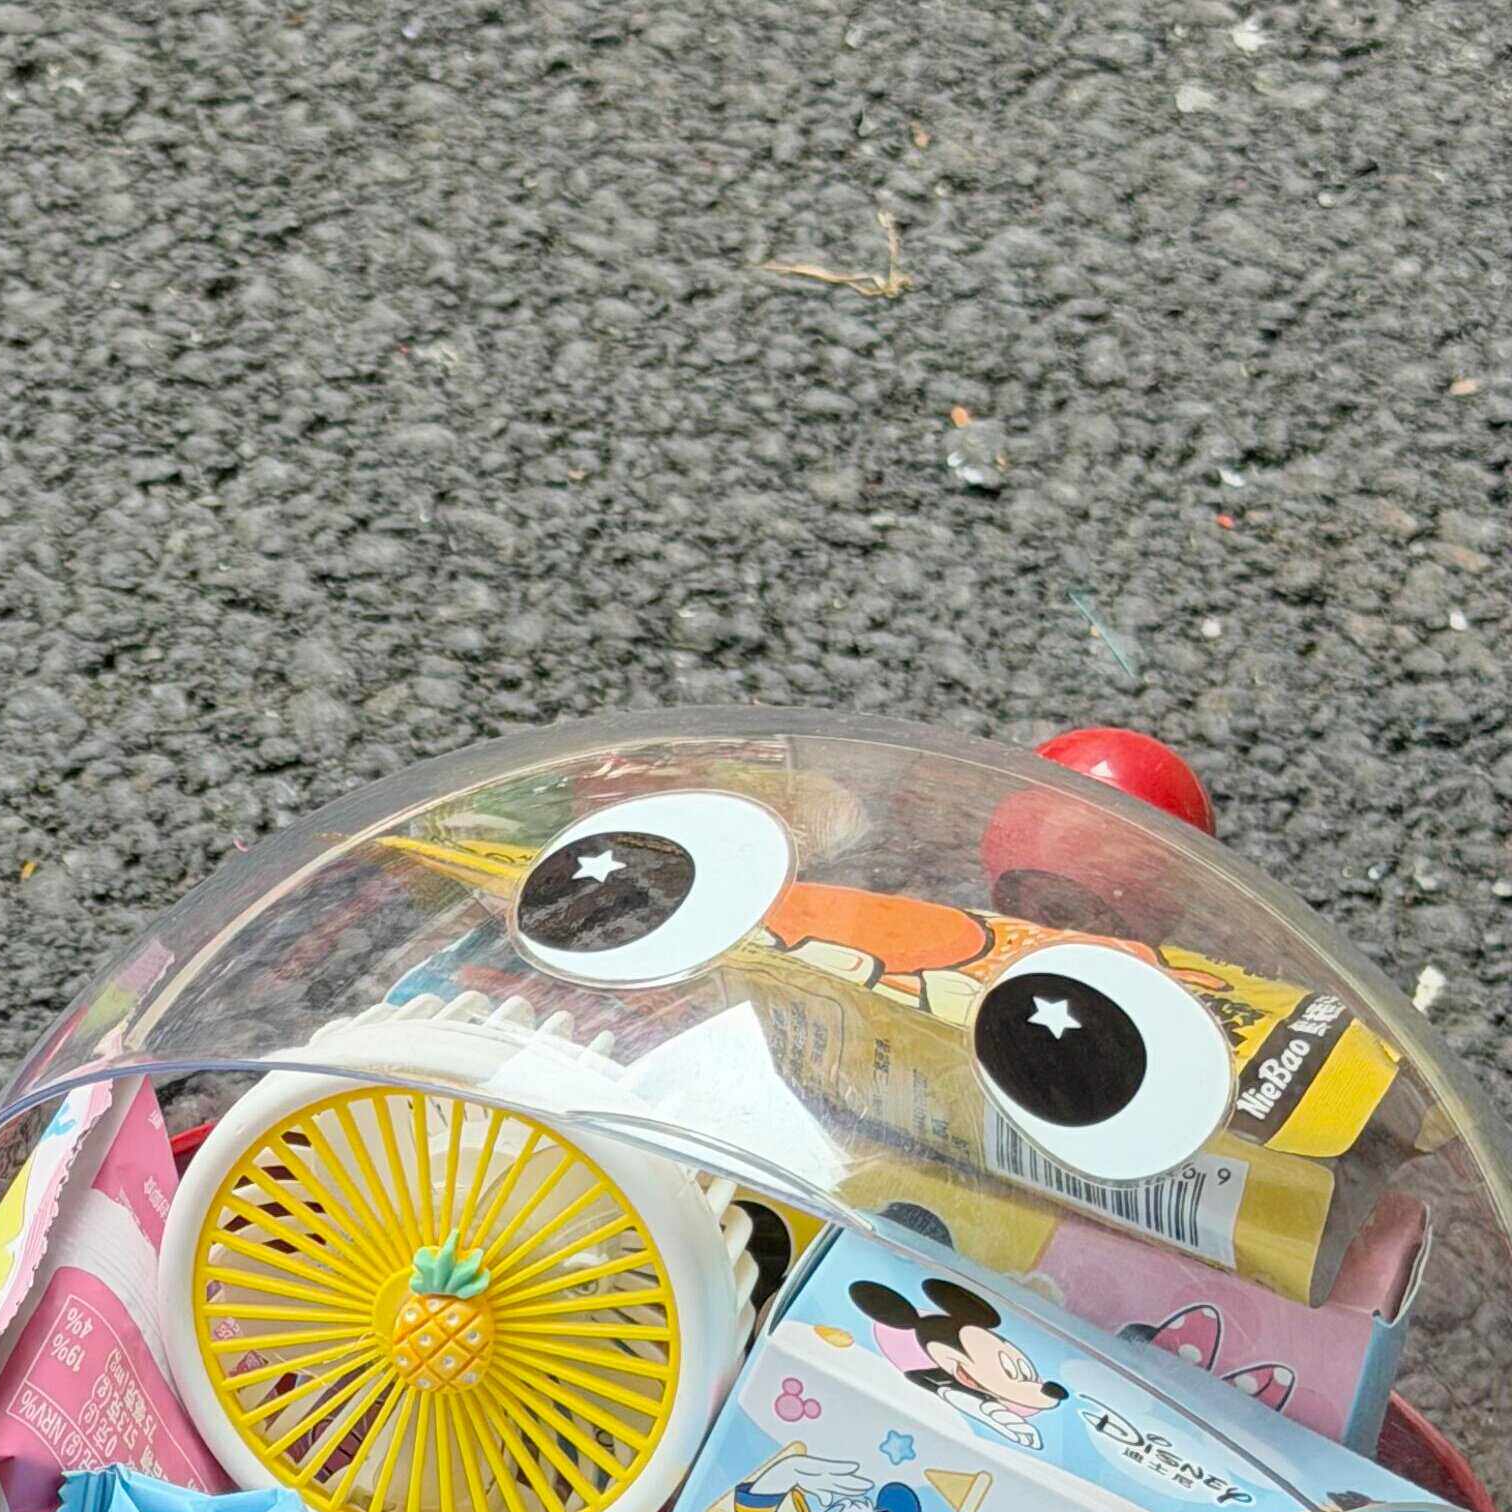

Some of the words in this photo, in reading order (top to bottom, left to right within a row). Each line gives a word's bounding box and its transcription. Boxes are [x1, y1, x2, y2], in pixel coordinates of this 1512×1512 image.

[1237, 1038, 1310, 1122] NieBao
[67, 1306, 93, 1339] 4%
[51, 1333, 86, 1372] 19%
[19, 1390, 66, 1446] NRV%
[78, 1402, 118, 1458] 0克(g)
[1121, 1446, 1194, 1490] 迪士尼
